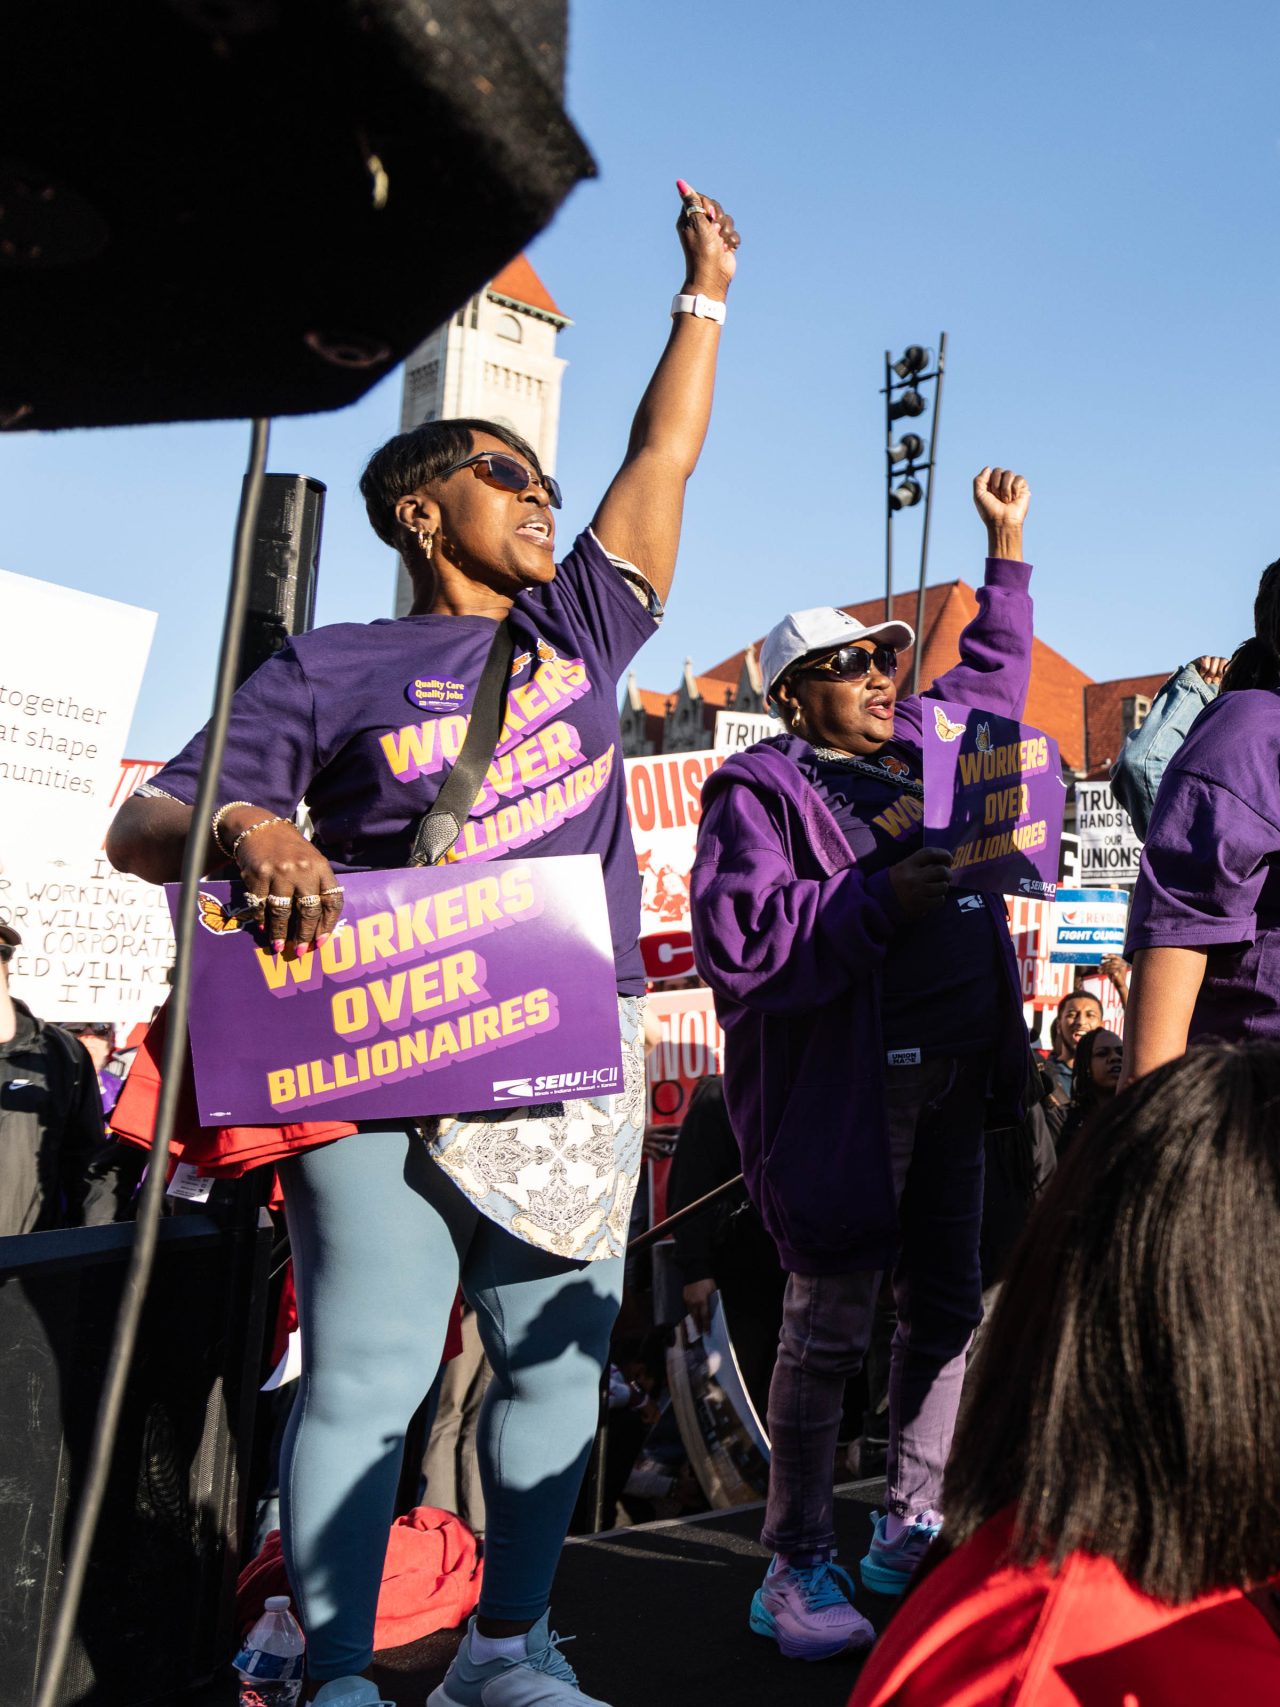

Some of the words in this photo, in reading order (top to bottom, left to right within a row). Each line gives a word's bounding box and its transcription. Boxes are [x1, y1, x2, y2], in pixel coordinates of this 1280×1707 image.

[415, 680, 444, 690] Quality
[446, 681, 464, 690] Care
[416, 690, 445, 700] Quality
[446, 691, 463, 700] Jobs
[0, 685, 107, 724] together
[379, 659, 592, 783] WOKERS
[25, 727, 98, 761] shape
[468, 719, 588, 816] VER
[959, 736, 1050, 786] WORKERS
[984, 783, 1030, 827] OVER
[1080, 813, 1122, 829] HANDS
[951, 819, 1047, 870] BILLIONAIRES
[1104, 834, 1122, 845] OUR
[27, 882, 137, 905] WORKING
[38, 910, 98, 930] WILL
[104, 911, 152, 933] SAVE
[255, 866, 544, 998] WORKERS
[1058, 930, 1093, 941] FIGHT
[43, 932, 176, 958] CORPORATE
[63, 960, 131, 981] WILL
[332, 949, 487, 1042] OVER
[267, 988, 560, 1112] BILLIONAIRES
[534, 1072, 581, 1091] SEIU
